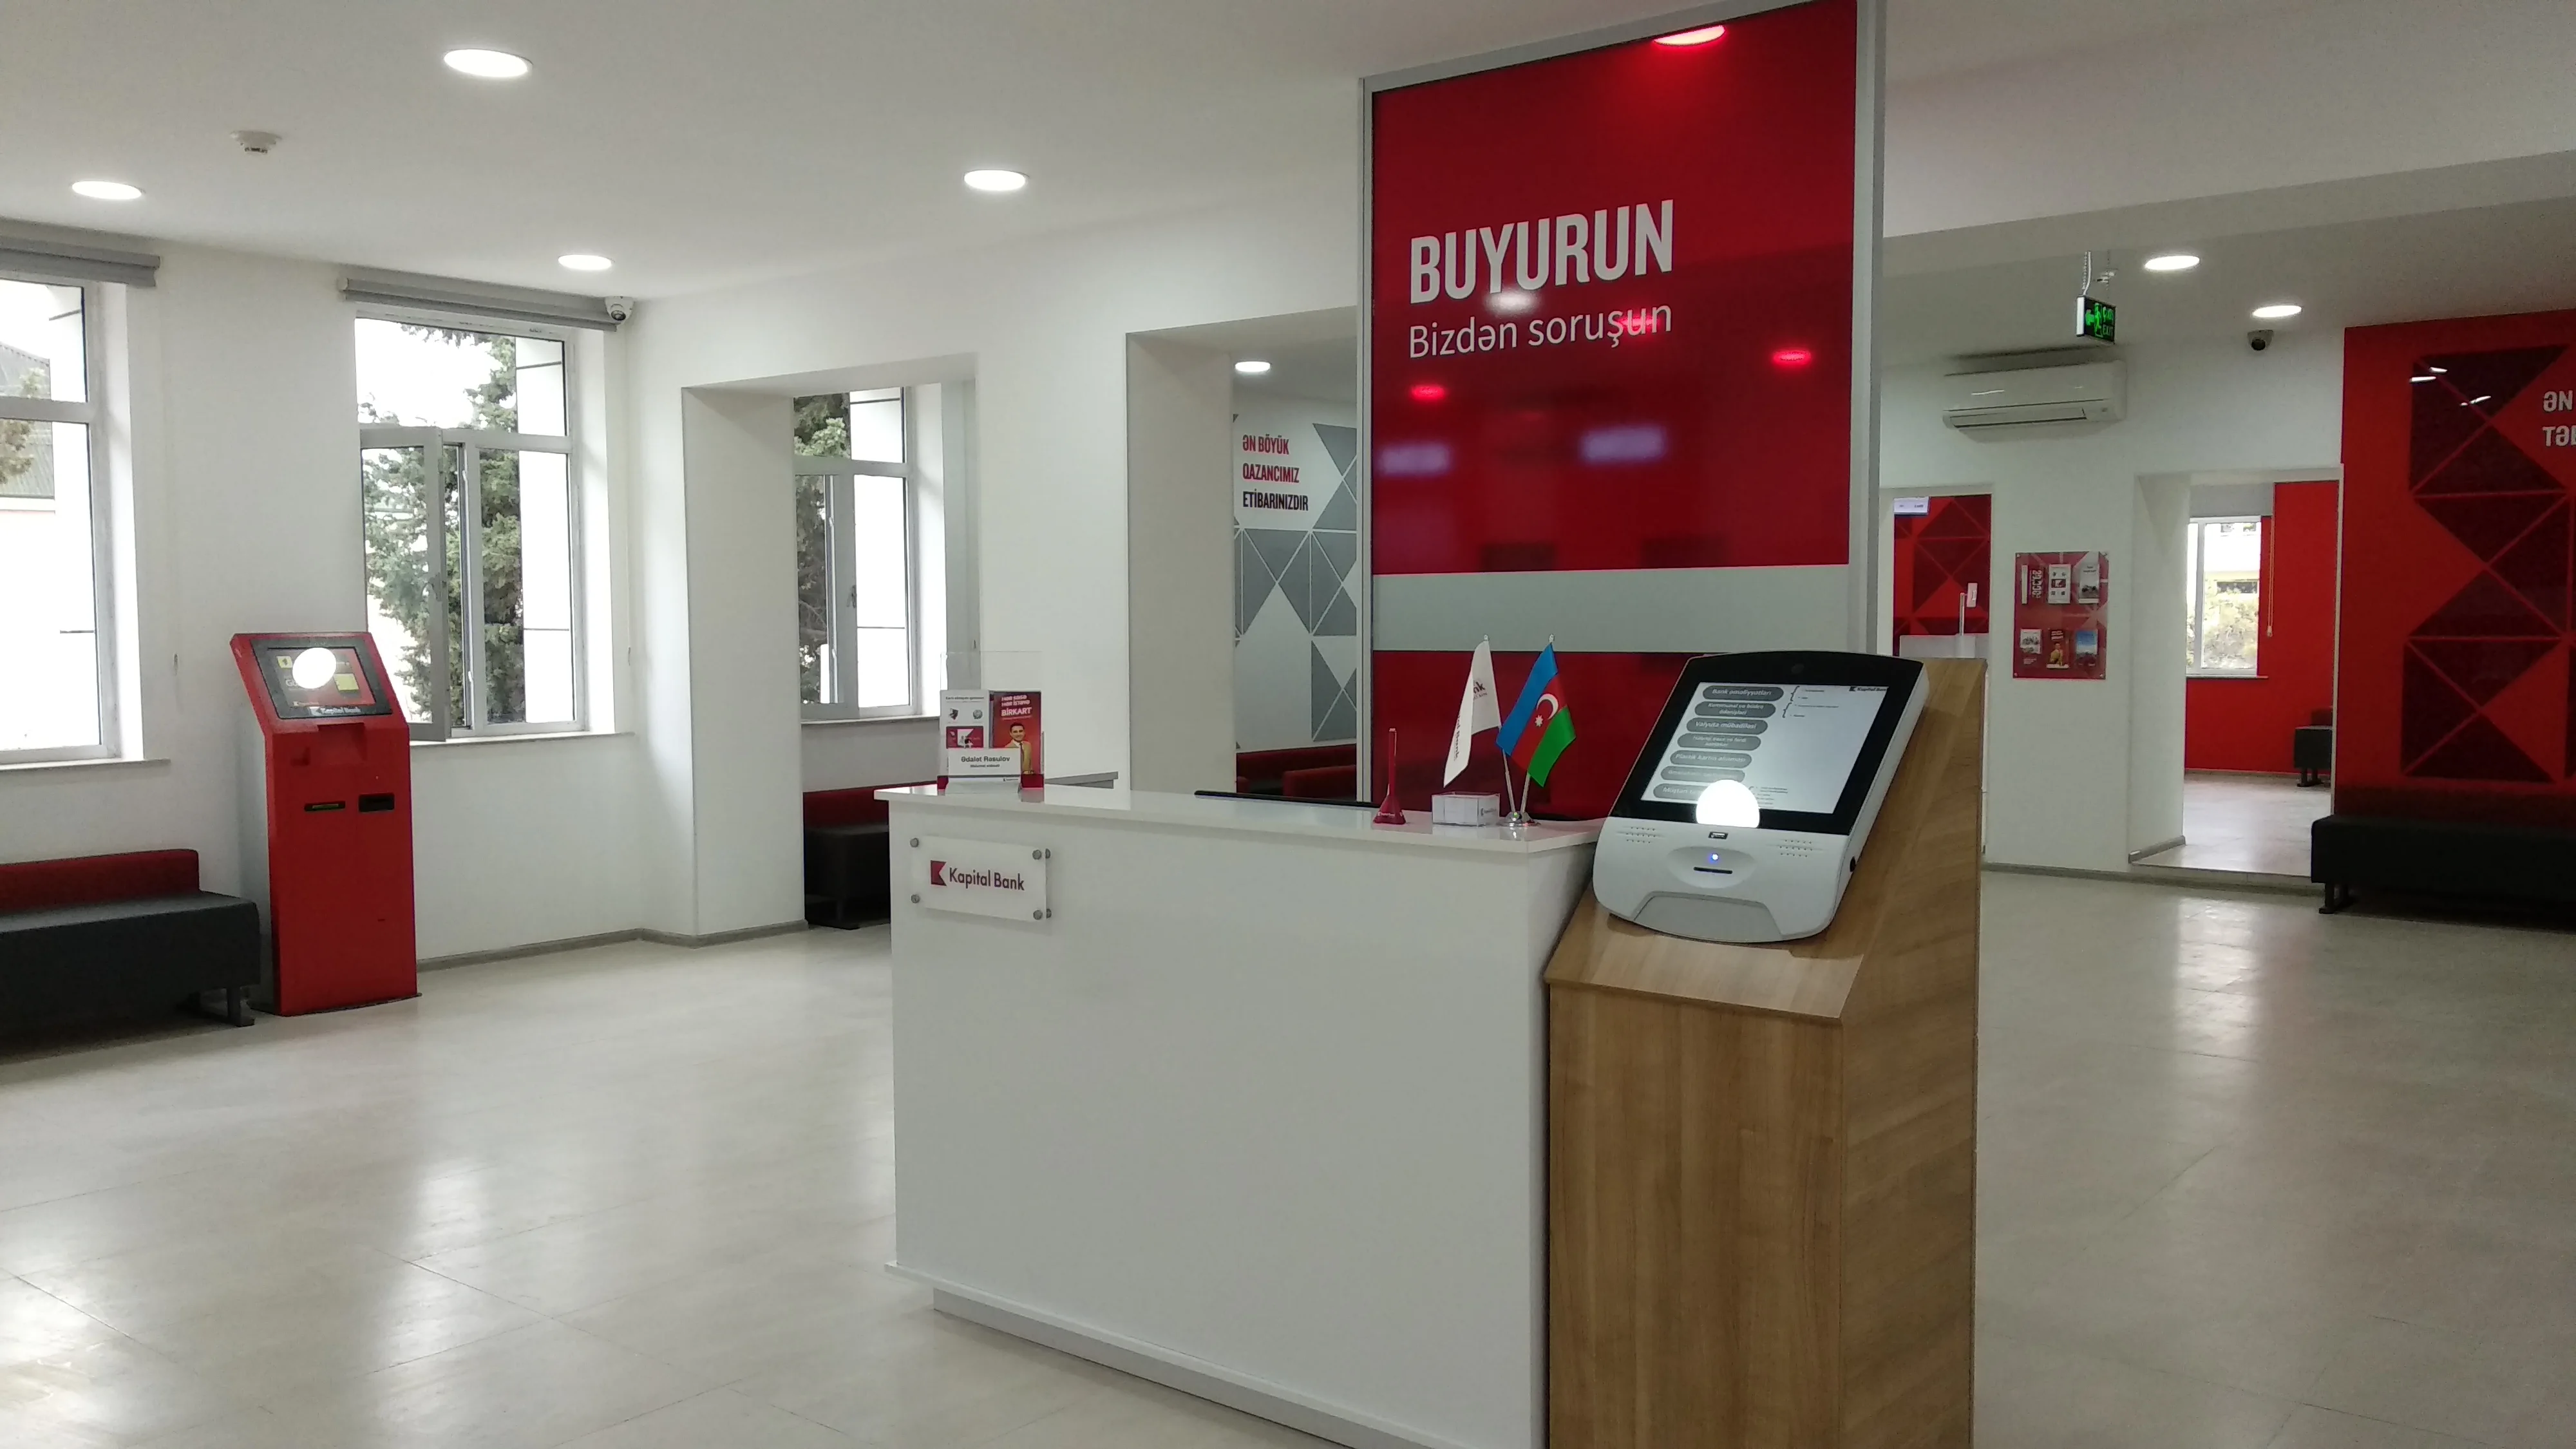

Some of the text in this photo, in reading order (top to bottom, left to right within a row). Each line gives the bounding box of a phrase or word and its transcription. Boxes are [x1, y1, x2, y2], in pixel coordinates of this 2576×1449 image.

[1410, 199, 1673, 304] BUYURUN
[1410, 304, 1672, 359] Bizdən soruşun
[2543, 390, 2573, 412] ƏN
[1242, 433, 1289, 455] ƏN BÖYÜK
[1242, 462, 1300, 484] QAZANCIMIZ
[1242, 488, 1309, 511] ETİBARINIZDIR
[1001, 707, 1032, 716] BİRKART
[949, 867, 1025, 891] Kapital Bank
